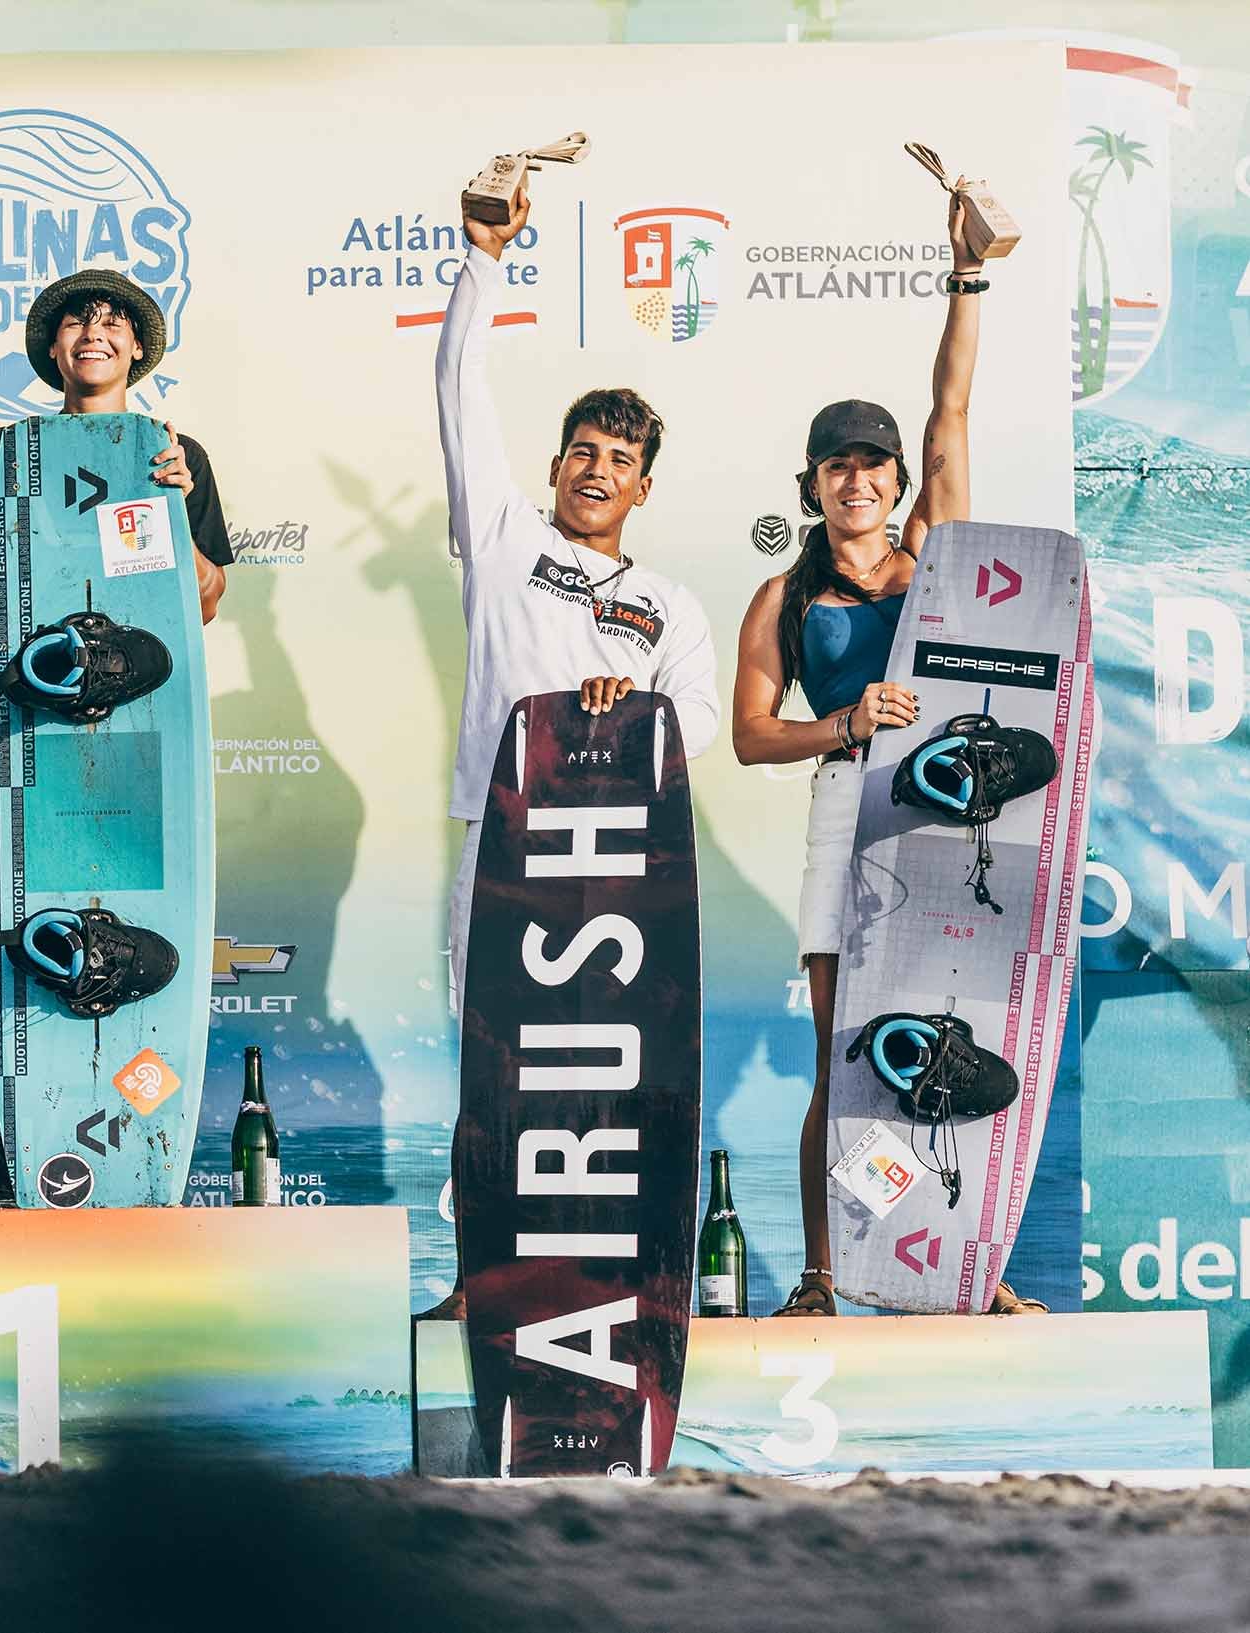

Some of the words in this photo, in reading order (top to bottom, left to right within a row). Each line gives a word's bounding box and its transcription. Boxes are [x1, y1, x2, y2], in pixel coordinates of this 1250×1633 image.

[342, 213, 538, 251] Atláno
[746, 241, 915, 263] GOBERNACIÓN
[307, 265, 383, 296] para
[396, 257, 424, 287] la
[435, 257, 539, 287] Gte
[926, 654, 1046, 677] PORSCHE
[1055, 663, 1073, 726] DUOTONE
[294, 740, 320, 750] DEL
[1071, 728, 1091, 811] TEAMSERIES
[1039, 808, 1056, 870] DUOTONE
[1054, 872, 1074, 956] TEAMSERIES
[1008, 953, 1026, 1014] DUOTONE
[1023, 1018, 1043, 1101] TEAMSERIES
[515, 805, 649, 1390] AIRUSH
[299, 1174, 327, 1186] DEL
[1005, 1163, 1025, 1245] TEAMSERIES
[757, 1351, 839, 1467] 3
